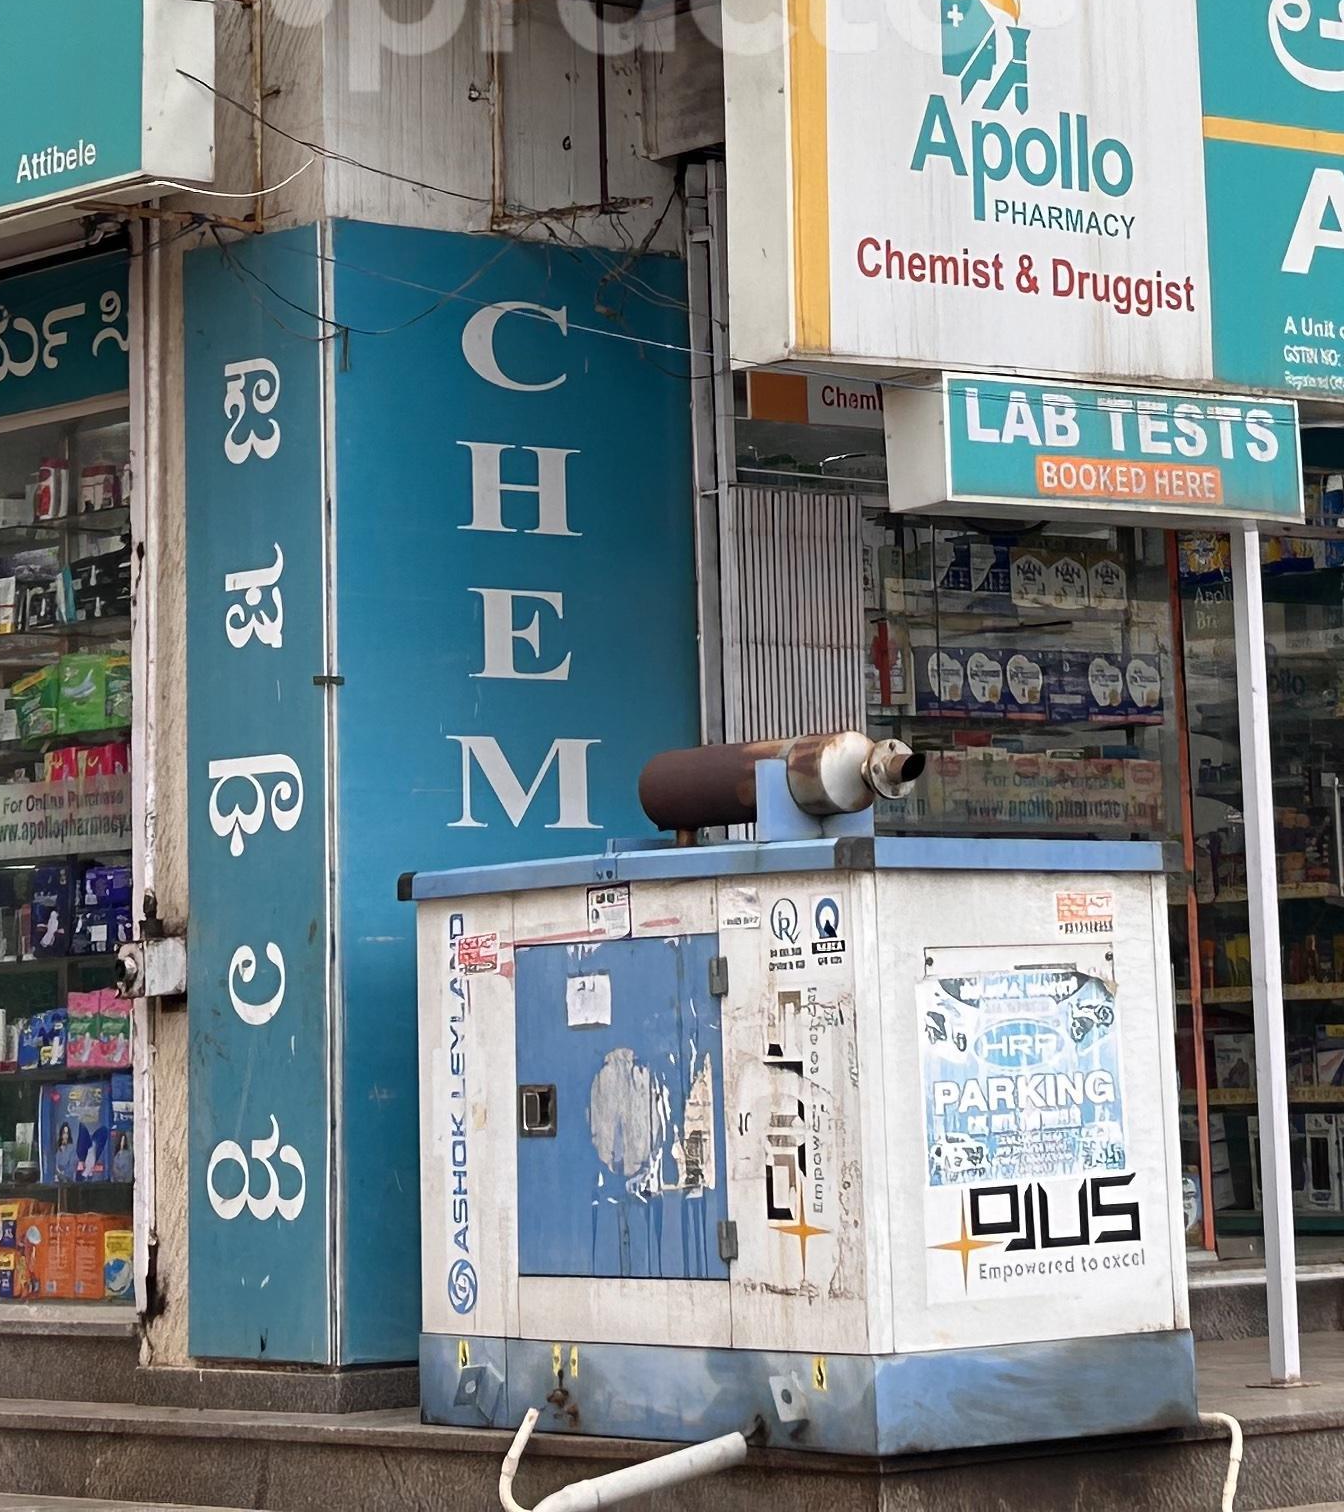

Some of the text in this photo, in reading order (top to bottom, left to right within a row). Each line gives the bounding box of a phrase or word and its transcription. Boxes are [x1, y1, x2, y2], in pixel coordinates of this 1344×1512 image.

[16, 140, 98, 185] Attibele
[909, 93, 1135, 222] Apollo
[993, 198, 1135, 240] PHARMACY
[856, 235, 1196, 317] Chemist & Druggist
[1284, 316, 1297, 334] A
[1301, 317, 1335, 339] Unit
[964, 387, 1280, 464] LAB TESTS
[1042, 460, 1219, 500] BOOKED HERE
[933, 1069, 1116, 1116] PARKING
[450, 1112, 470, 1253] ASHOK
[979, 1257, 1075, 1283] Empowered
[1081, 1256, 1098, 1272] to
